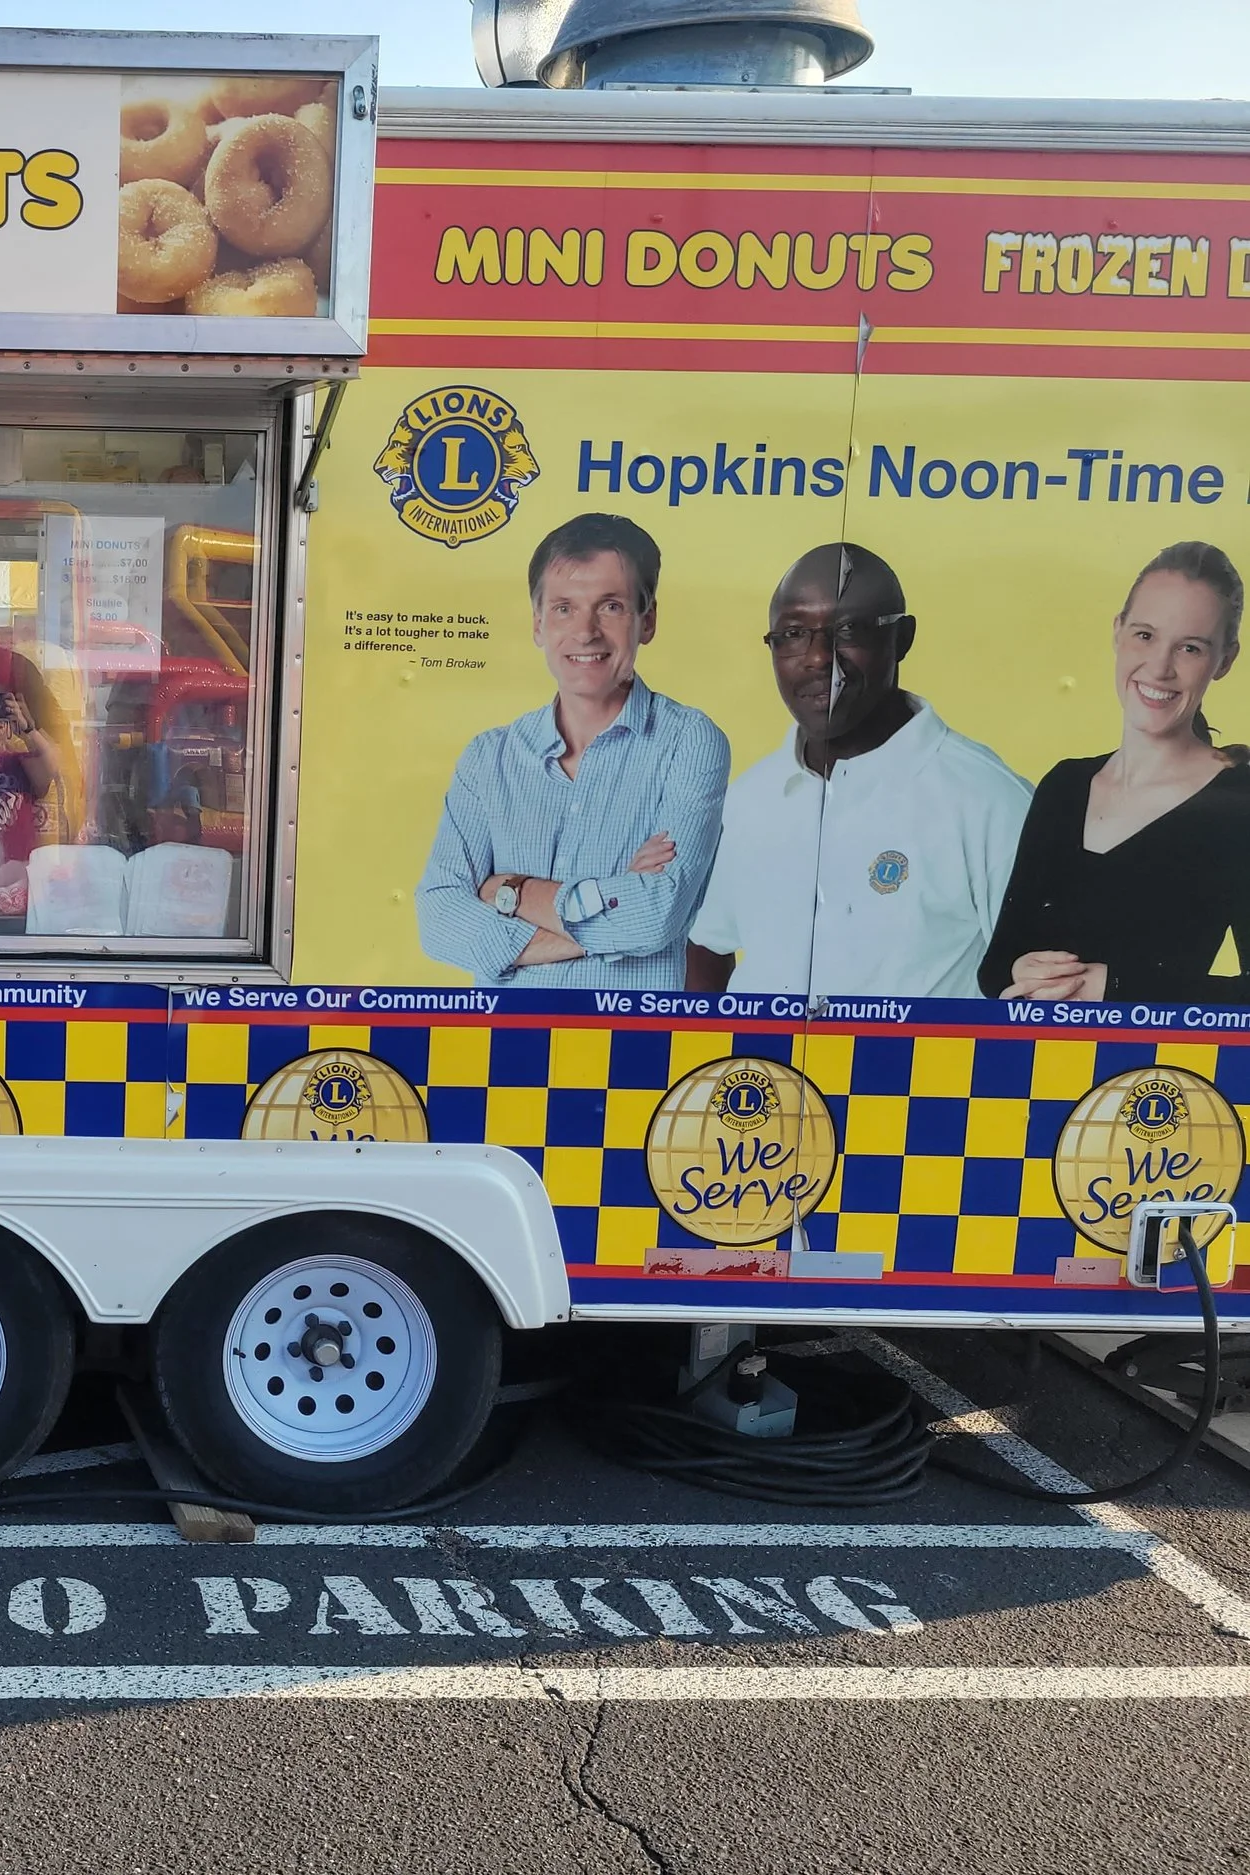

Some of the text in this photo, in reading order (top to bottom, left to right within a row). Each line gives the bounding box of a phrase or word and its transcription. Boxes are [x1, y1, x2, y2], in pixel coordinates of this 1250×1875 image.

[434, 225, 934, 293] MINI DONUTS
[983, 231, 1210, 297] FROZEN
[413, 392, 508, 427] LIONS
[439, 437, 479, 491] L
[579, 440, 845, 508] Hopkins
[868, 445, 1225, 505] Noon-Time
[408, 504, 501, 535] INTERNATIONAL
[96, 540, 141, 550] DONUTS
[345, 610, 490, 625] It's easy to make a buck.
[344, 625, 490, 639] It's a lot tougher to make
[343, 640, 416, 652] a difference.
[420, 657, 486, 669] Tom Brokaw
[184, 986, 500, 1014] We Serve Our Community
[595, 992, 912, 1023] We Serve Our Comunity
[1007, 1002, 1045, 1022] We
[1052, 1003, 1123, 1024] Serve
[1130, 1005, 1176, 1026] Our
[319, 1065, 358, 1078] LIONS
[728, 1072, 767, 1086] LIONS
[329, 1082, 347, 1103] L
[737, 1089, 754, 1111] L
[1138, 1082, 1176, 1096] LIONS
[317, 1108, 356, 1120] INTERNATIONAL
[1146, 1099, 1164, 1121] L
[725, 1115, 764, 1128] INTERNATIONAL
[1133, 1127, 1172, 1138] INTERNATIONAL
[717, 1137, 795, 1176] We
[1125, 1147, 1203, 1186] We
[673, 1166, 821, 1215] Serve
[191, 1575, 925, 1637] PARKING
